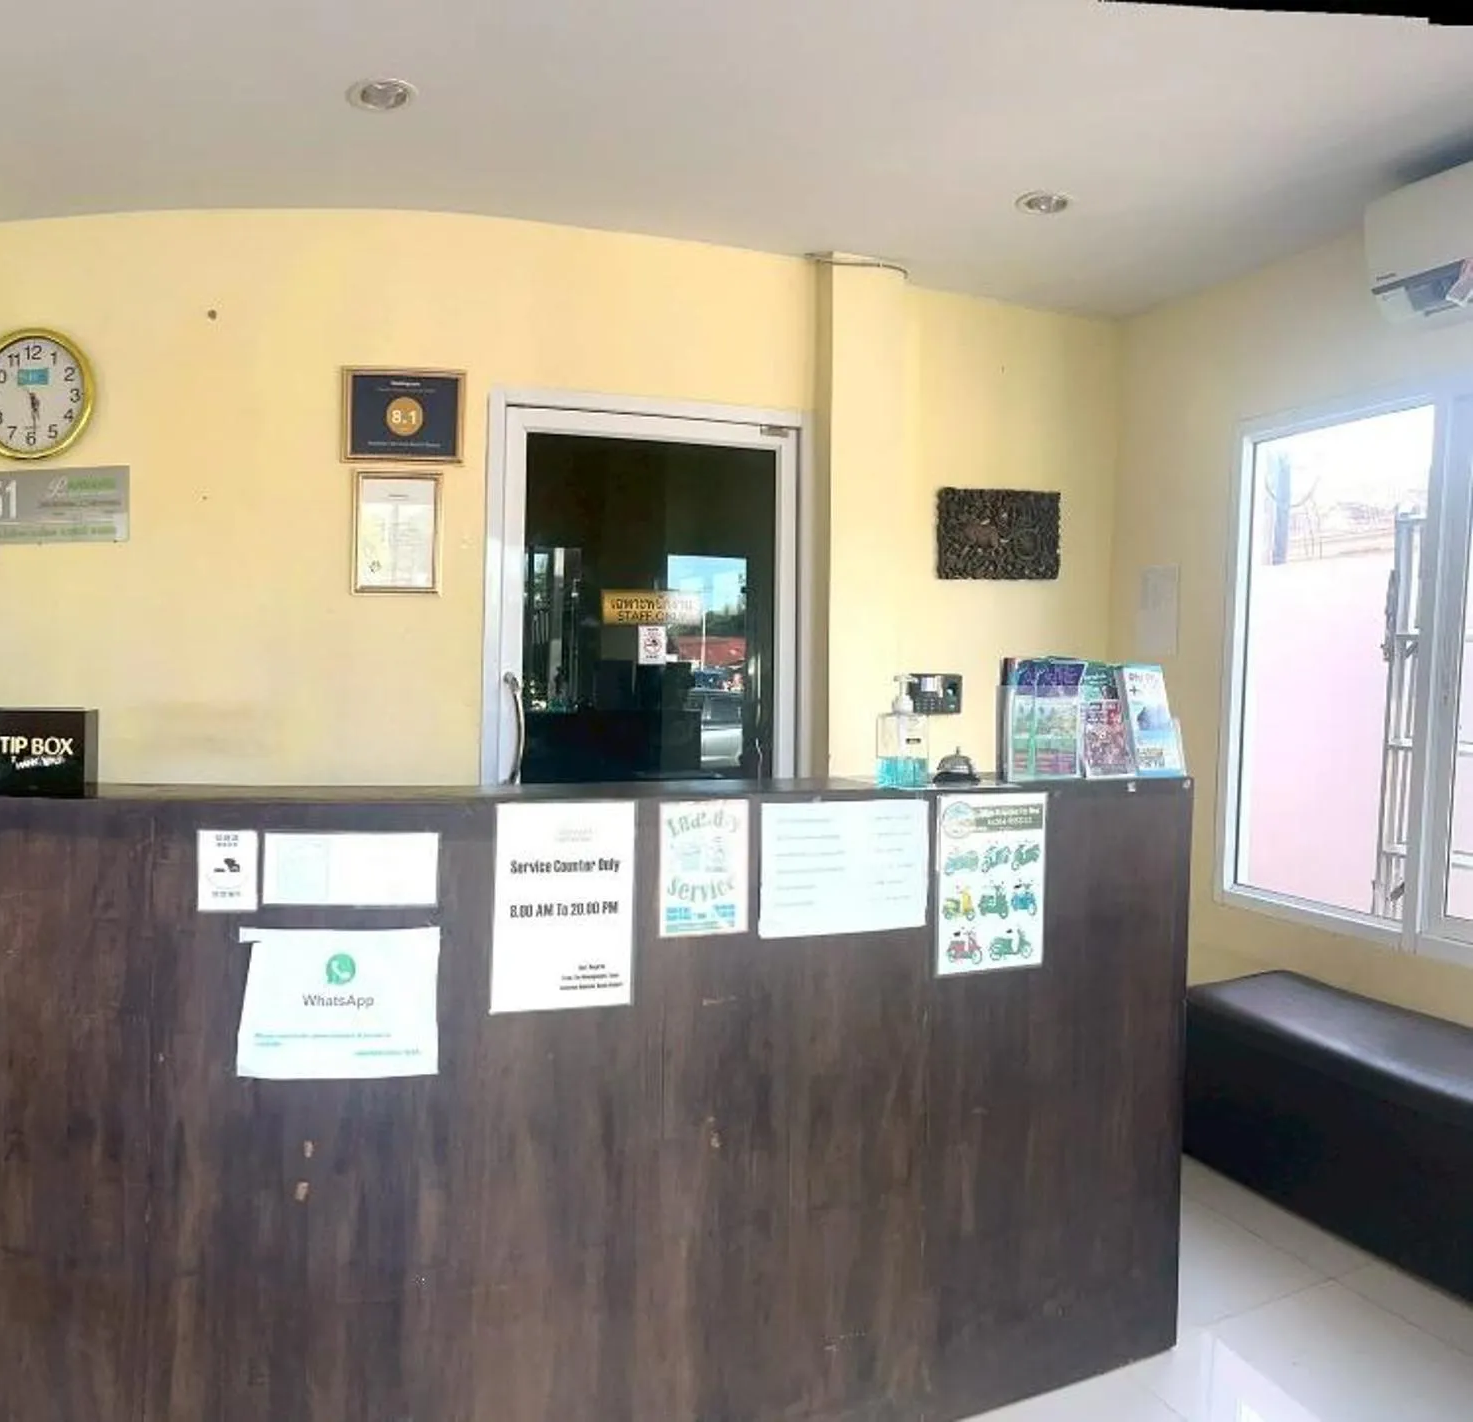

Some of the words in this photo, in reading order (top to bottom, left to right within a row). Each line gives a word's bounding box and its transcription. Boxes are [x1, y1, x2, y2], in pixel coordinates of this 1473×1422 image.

[25, 345, 42, 360] 12
[50, 352, 58, 365] 1
[7, 354, 21, 367] 11
[64, 367, 76, 382] 2
[70, 388, 82, 403] 3
[64, 408, 74, 422] 4
[391, 409, 417, 425] 8.1
[7, 425, 18, 440] 7
[25, 431, 36, 446] 6
[48, 424, 58, 439] 5
[0, 736, 28, 754] TIP
[31, 736, 73, 756] BOX
[510, 860, 552, 874] Service
[554, 859, 596, 873] Counter
[598, 858, 620, 873] Only
[510, 904, 533, 918] 8.00
[536, 903, 554, 917] AM
[570, 902, 600, 917] 20.00
[602, 901, 618, 915] PM
[302, 993, 375, 1010] WhatsApp
